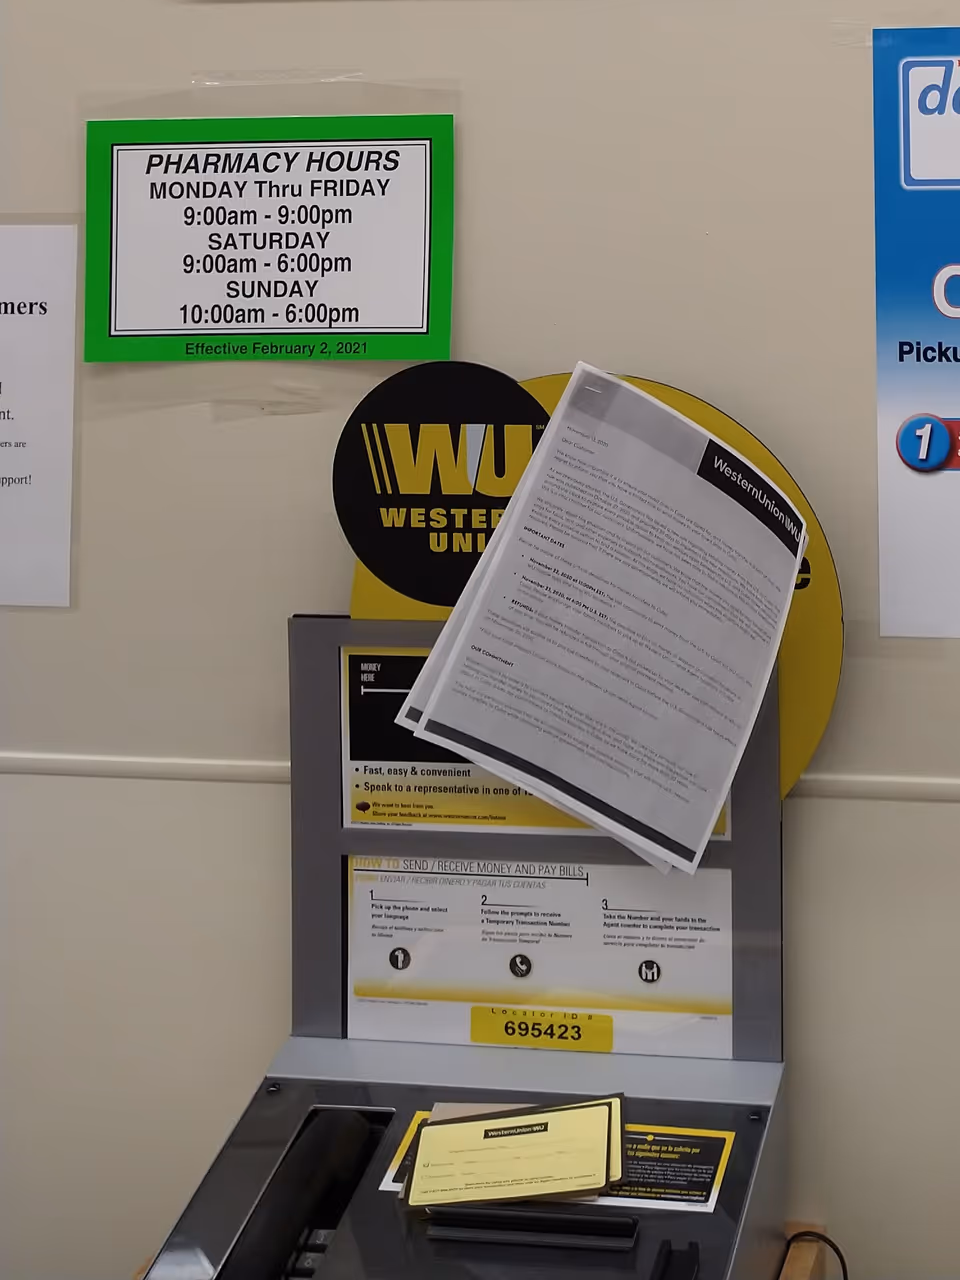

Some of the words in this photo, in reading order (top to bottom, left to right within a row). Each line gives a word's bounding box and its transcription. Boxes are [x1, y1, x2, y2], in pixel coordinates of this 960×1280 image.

[145, 152, 299, 174] PHARMACY
[305, 150, 400, 172] HOURS
[150, 180, 246, 200] MONDAY
[254, 180, 302, 198] Thru
[310, 179, 391, 197] FRIDAY
[183, 207, 258, 226] 9:00am
[277, 205, 353, 226] 9:00pm
[208, 232, 330, 250] SATURDAY
[183, 255, 258, 273] 9:00am
[277, 253, 352, 276] 6:00pm
[226, 280, 319, 298] SUNDAY
[180, 304, 265, 323] 10:00am
[285, 303, 360, 328] 6:00pm
[185, 342, 248, 355] Effective
[252, 342, 316, 357] February
[319, 342, 333, 356] 2,
[336, 341, 369, 355] 2021
[915, 424, 932, 459] 1
[374, 424, 532, 497] WU
[0, 475, 32, 486] pport!
[713, 456, 785, 524] WesternUnion
[380, 508, 505, 528] WESTE
[430, 532, 488, 552] UNI
[361, 663, 381, 672] MONEY
[361, 673, 375, 682] HERE
[364, 766, 384, 776] Fast,
[388, 767, 408, 778] easy
[411, 766, 418, 775] &
[421, 767, 471, 777] convenient
[364, 782, 392, 795] Speak
[394, 783, 403, 792] to
[406, 784, 411, 792] a
[414, 784, 479, 795] representative
[482, 785, 490, 794] in
[493, 787, 509, 796] one
[403, 860, 429, 870] SEND
[438, 860, 474, 873] RECEIVE
[477, 862, 512, 874] MONEY
[515, 864, 536, 875] AND
[539, 864, 558, 876] PAY
[560, 865, 584, 877] BILLS
[481, 894, 487, 905] 2
[602, 898, 608, 910] 3
[504, 1021, 582, 1041] 695423
